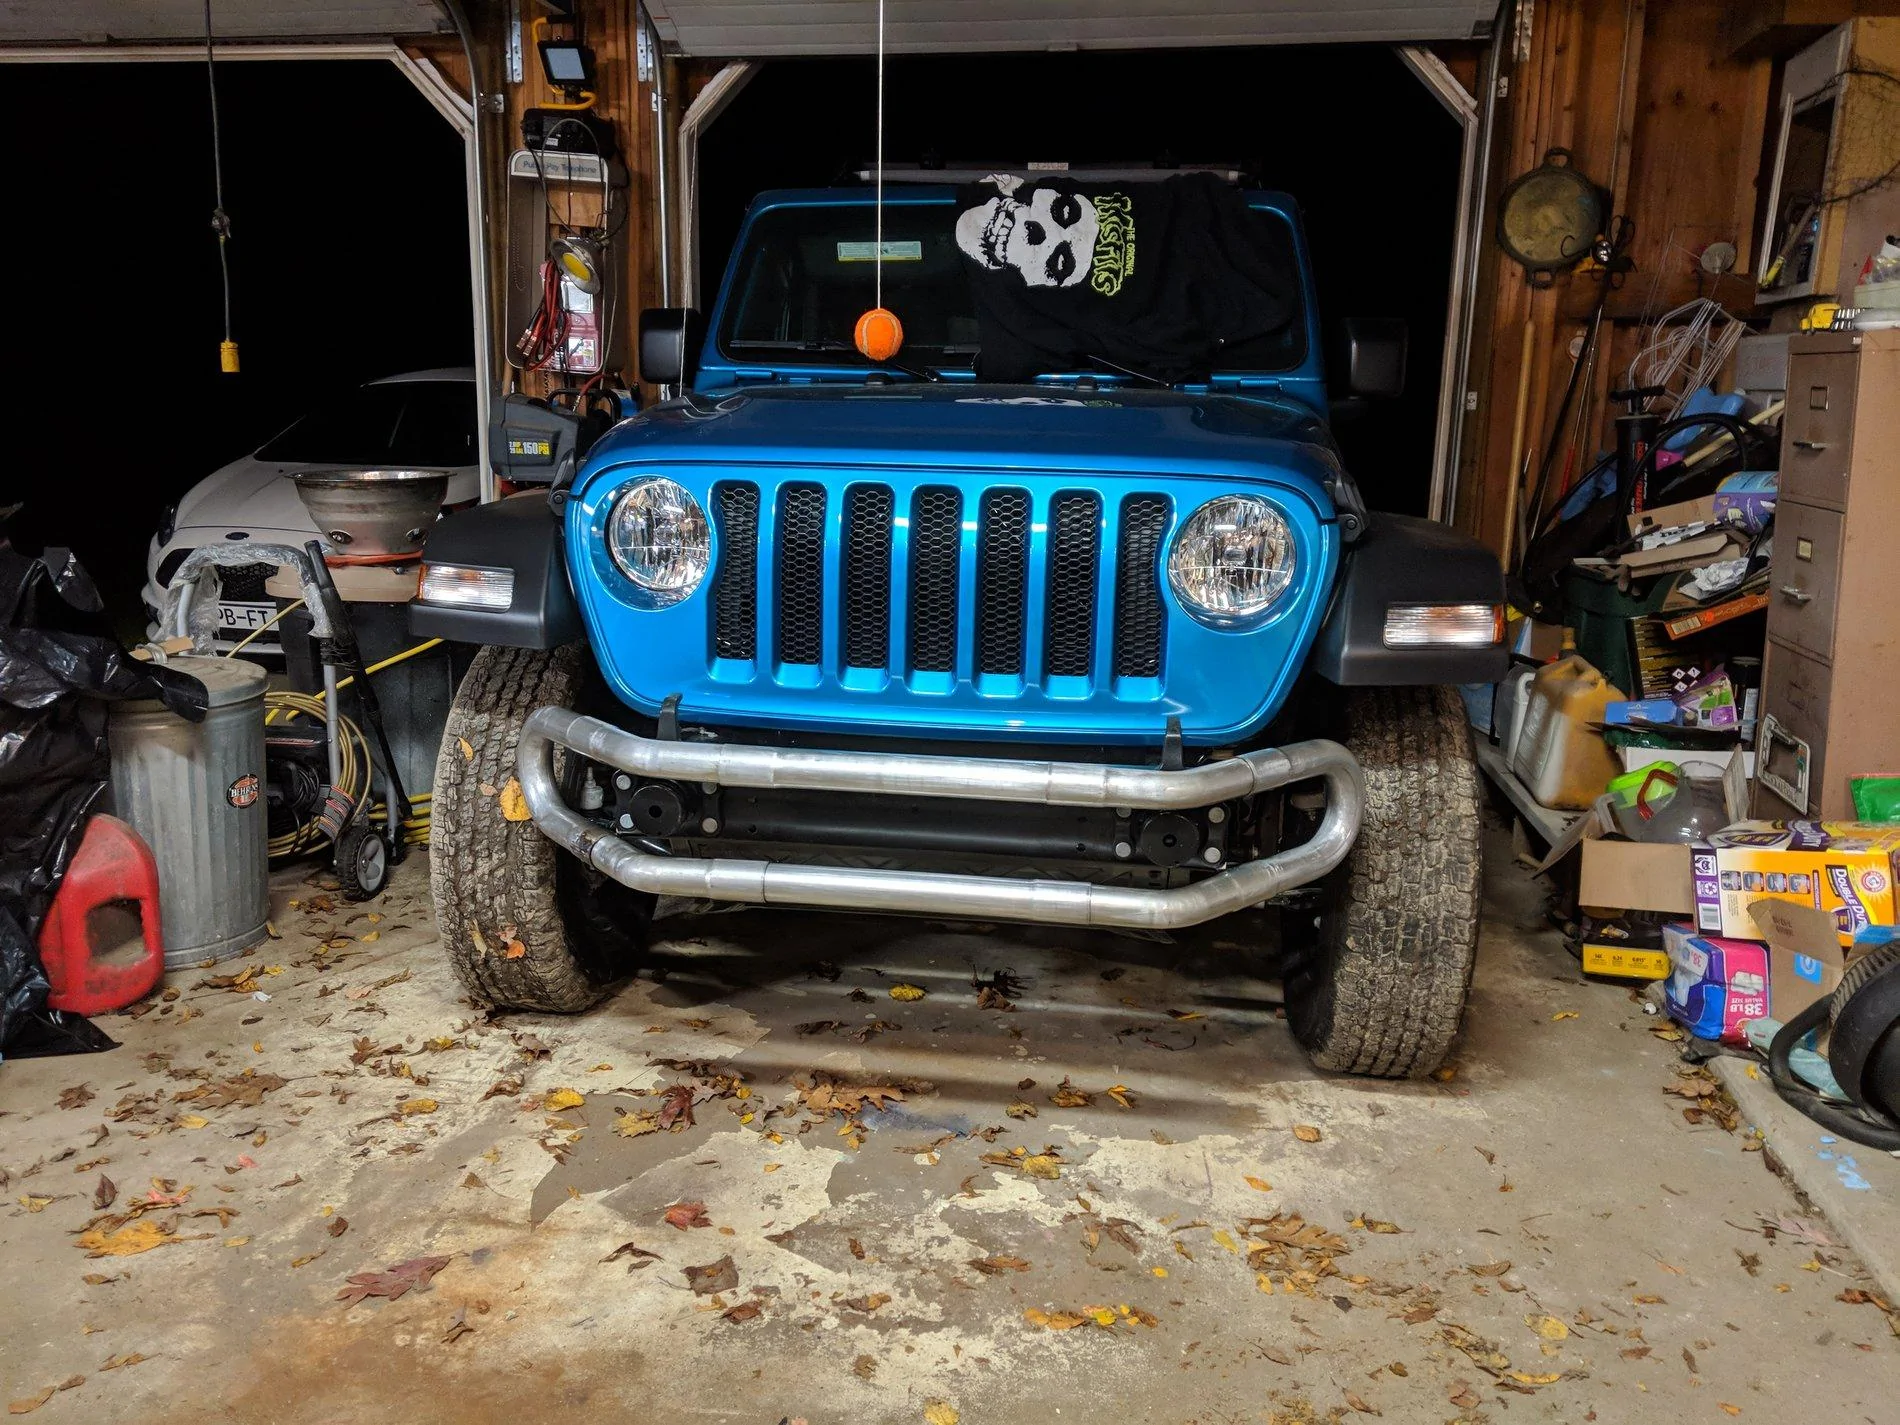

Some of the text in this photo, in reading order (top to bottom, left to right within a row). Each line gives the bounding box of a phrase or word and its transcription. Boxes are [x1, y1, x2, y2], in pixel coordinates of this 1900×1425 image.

[1125, 228, 1135, 276] THE ORIGINAL
[523, 441, 549, 455] 150 PSI
[1835, 868, 1859, 906] DOUBLE
